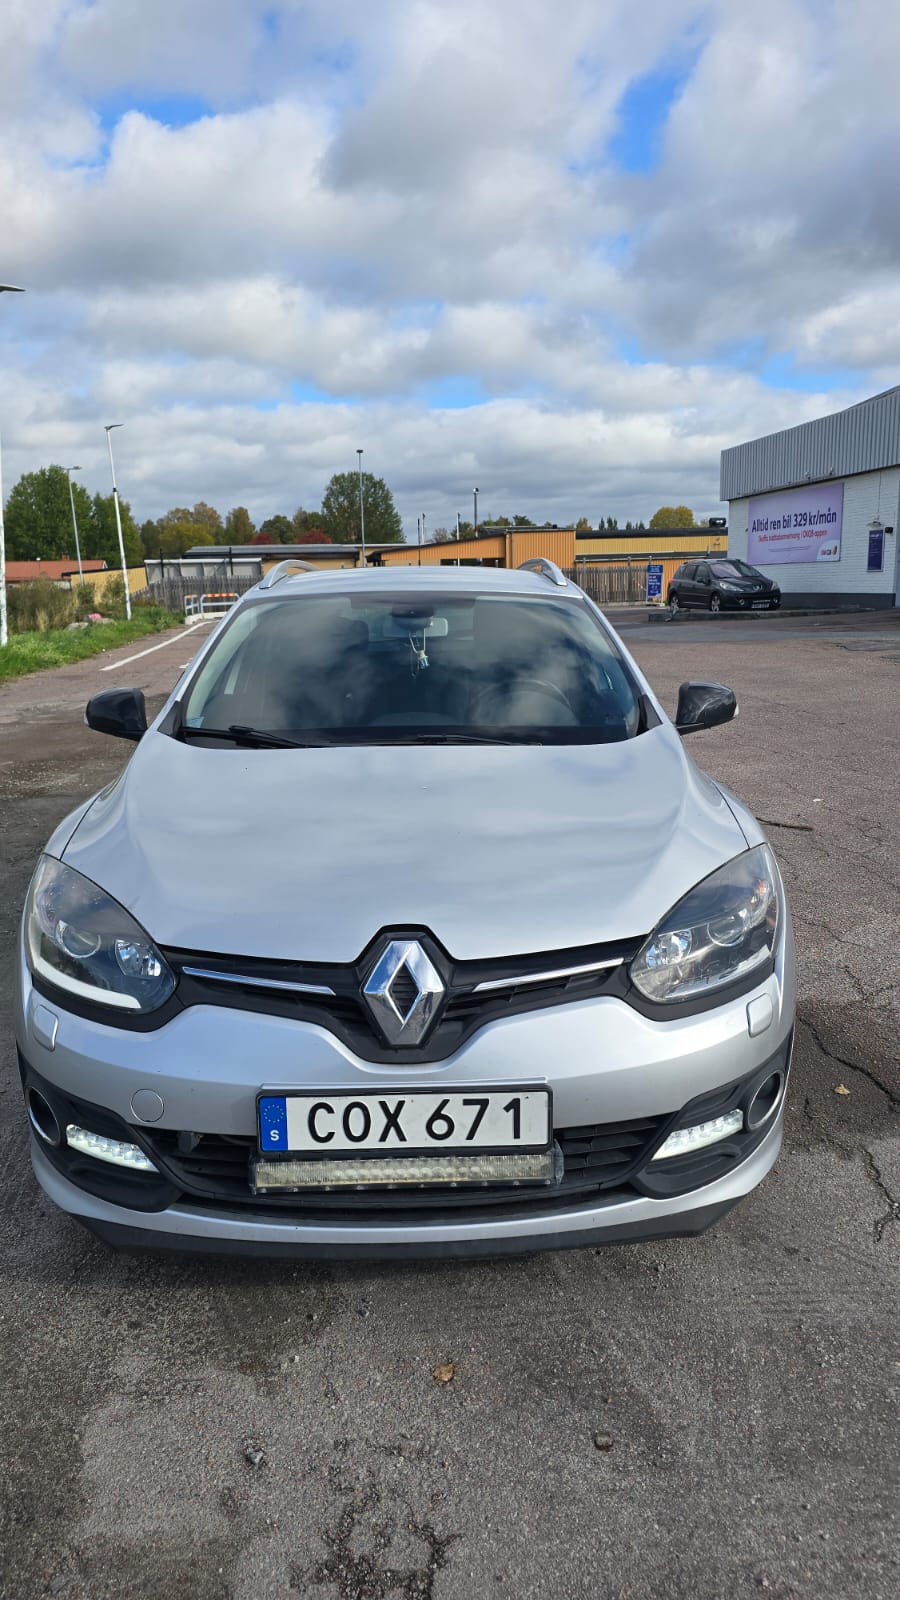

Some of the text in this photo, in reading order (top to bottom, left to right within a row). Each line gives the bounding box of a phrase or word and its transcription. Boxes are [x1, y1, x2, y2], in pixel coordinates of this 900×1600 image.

[752, 508, 836, 532] Alltid ren bil 329 kr/mån
[307, 1098, 522, 1144] COX 671
[270, 1129, 280, 1141] S
